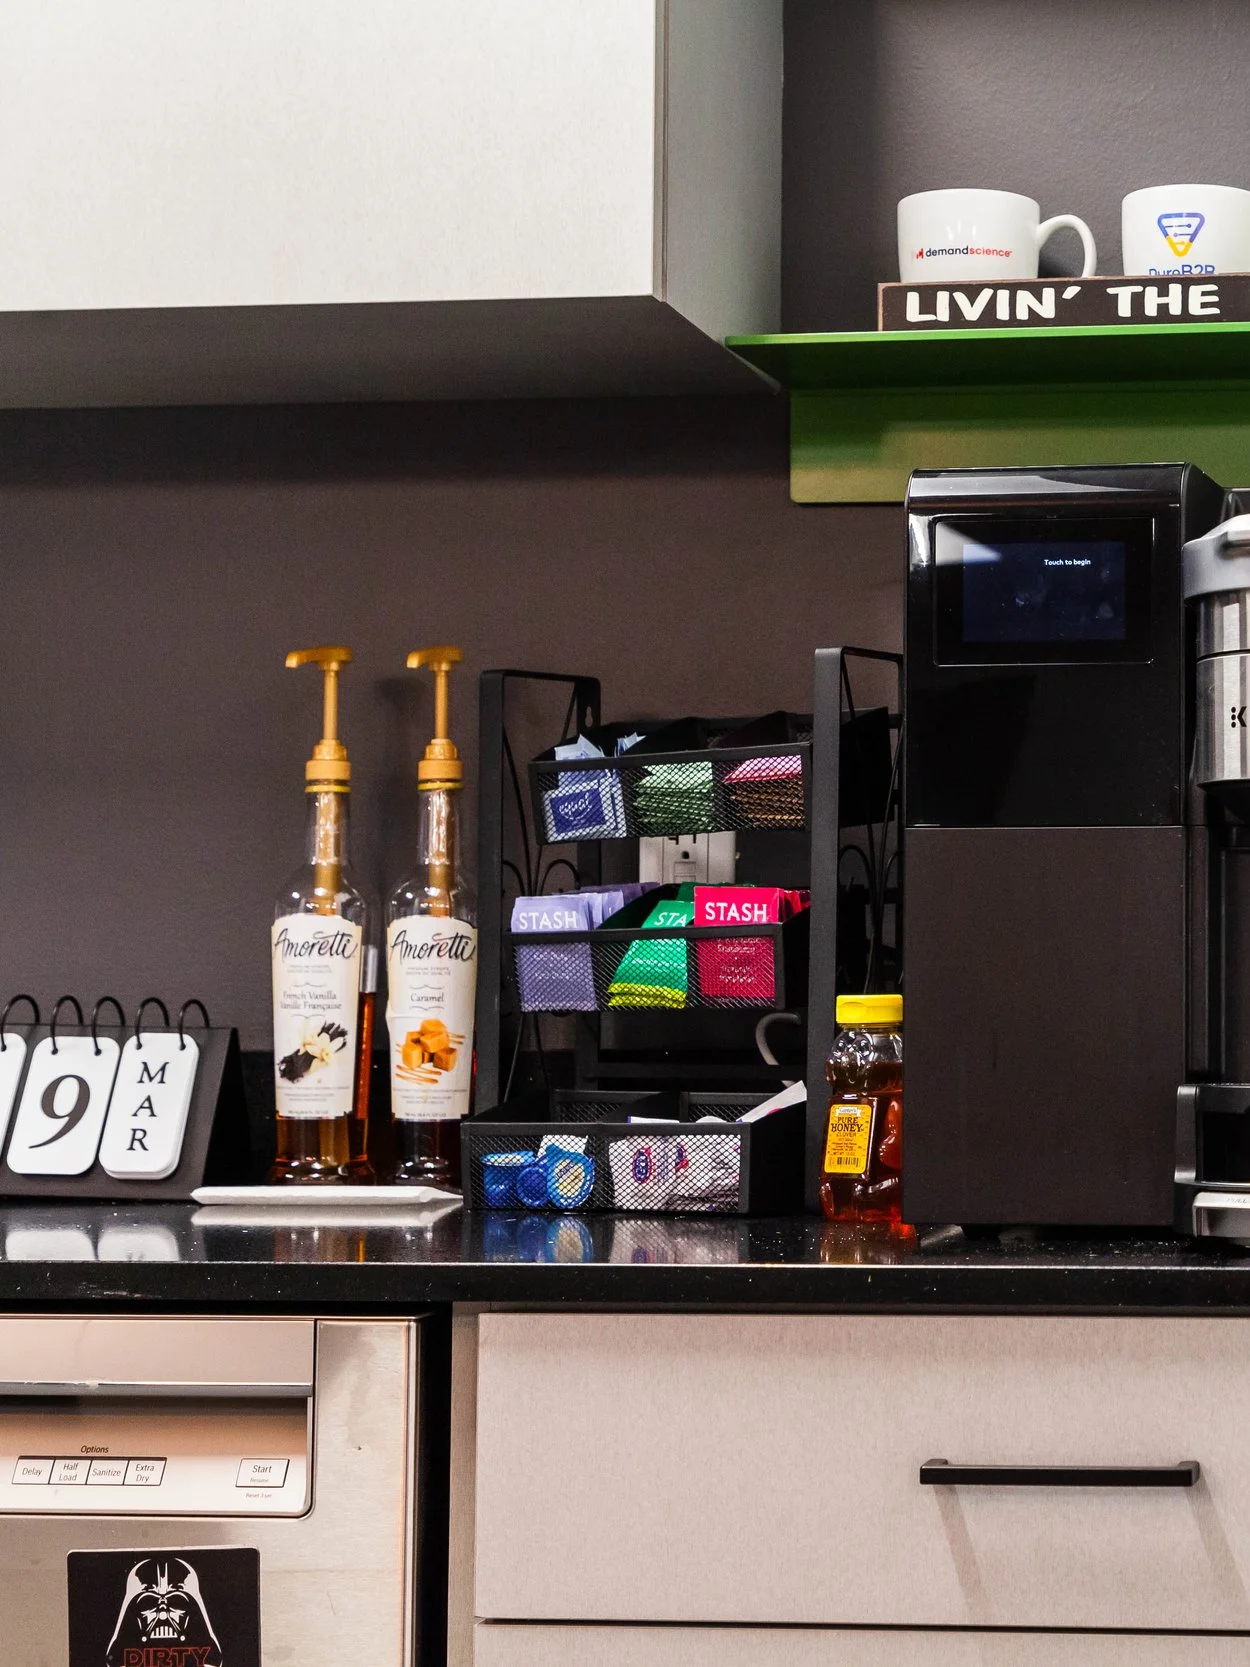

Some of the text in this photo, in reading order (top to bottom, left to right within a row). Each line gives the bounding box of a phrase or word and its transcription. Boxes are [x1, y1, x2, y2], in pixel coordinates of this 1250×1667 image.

[1106, 283, 1220, 318] THE
[705, 902, 768, 922] STASH
[518, 910, 578, 930] STASH
[653, 911, 689, 928] STA
[274, 927, 359, 963] Amoretti
[389, 929, 477, 965] Amoretti
[308, 990, 337, 1000] Vanilla
[410, 992, 445, 1002] Caramel
[28, 1074, 91, 1149] 9
[126, 1061, 170, 1152] MAR
[831, 1123, 863, 1132] HONEY
[80, 1445, 109, 1454] Options
[22, 1467, 43, 1477] Delay
[63, 1463, 79, 1471] Half
[135, 1463, 155, 1472] Extra
[252, 1464, 272, 1473] Start
[91, 1468, 122, 1477] Sanitize
[58, 1474, 78, 1482] Load
[136, 1474, 150, 1484] Dry
[123, 1646, 211, 1667] DIRTY
